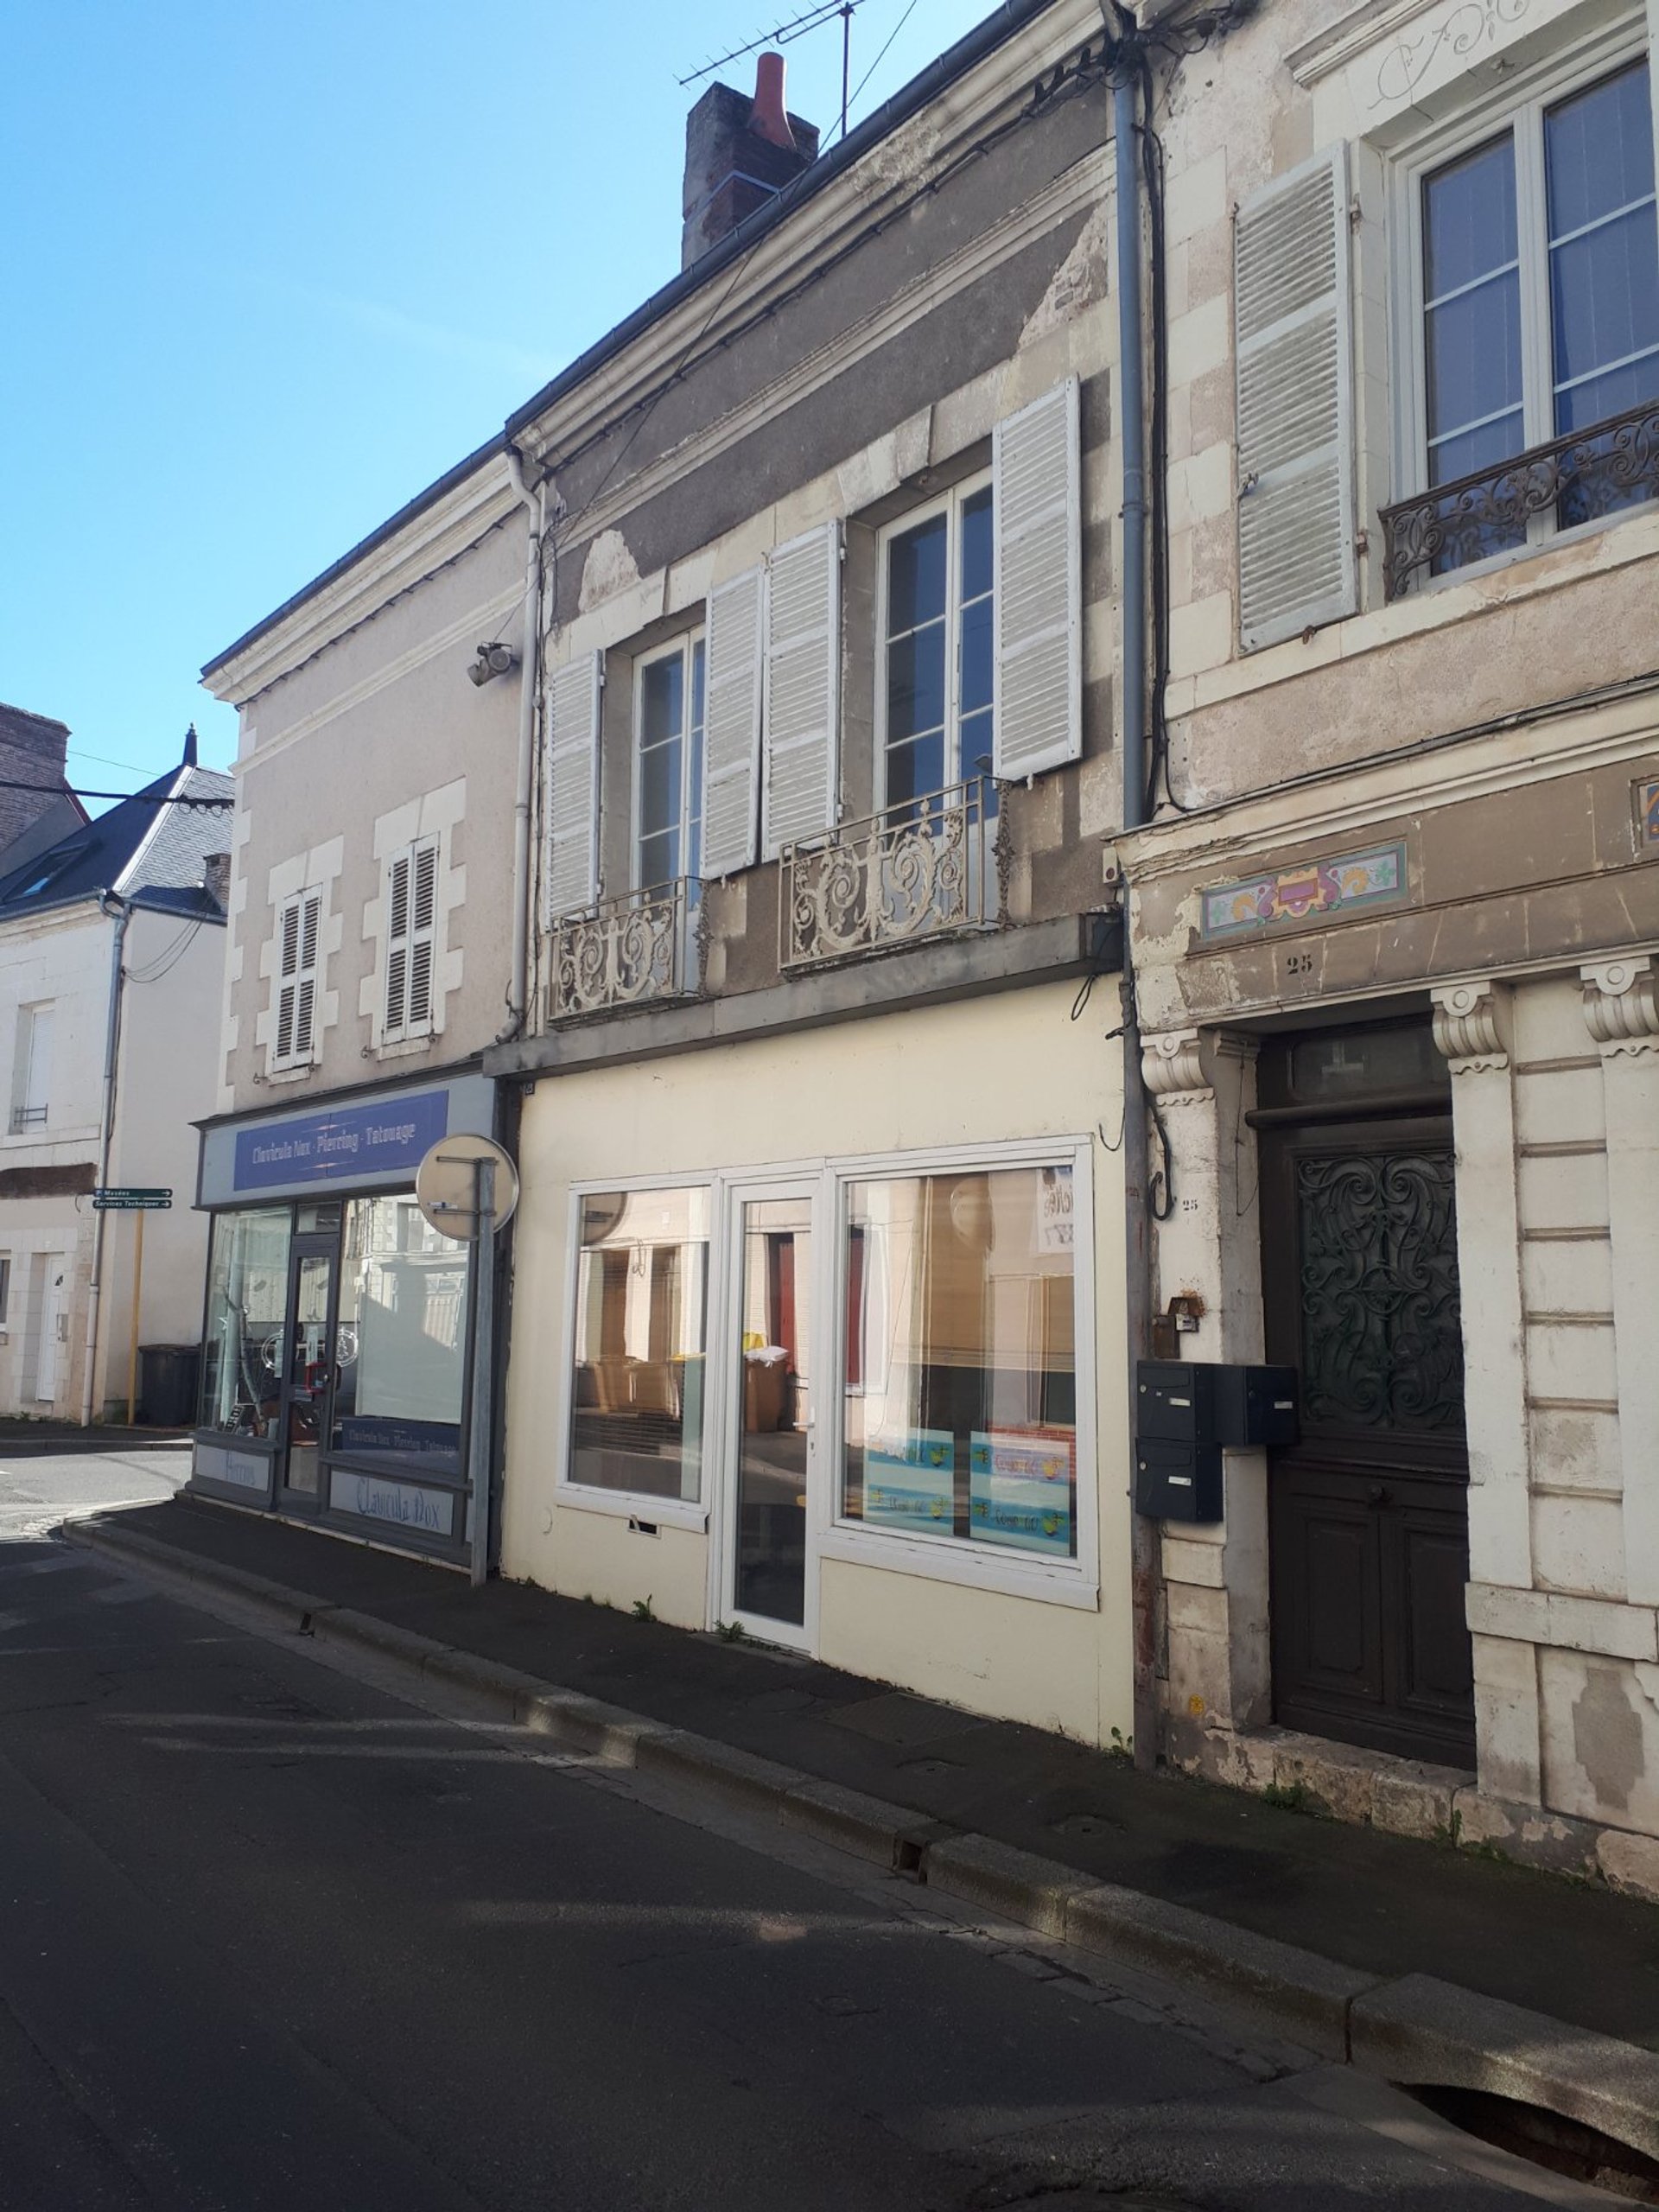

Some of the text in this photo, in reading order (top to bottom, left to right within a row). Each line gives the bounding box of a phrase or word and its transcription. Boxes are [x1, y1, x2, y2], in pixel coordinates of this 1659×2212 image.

[1286, 954, 1313, 976] 25
[316, 1129, 359, 1154] Piercing
[366, 1123, 416, 1146] Tatouage
[1182, 1198, 1198, 1211] 25
